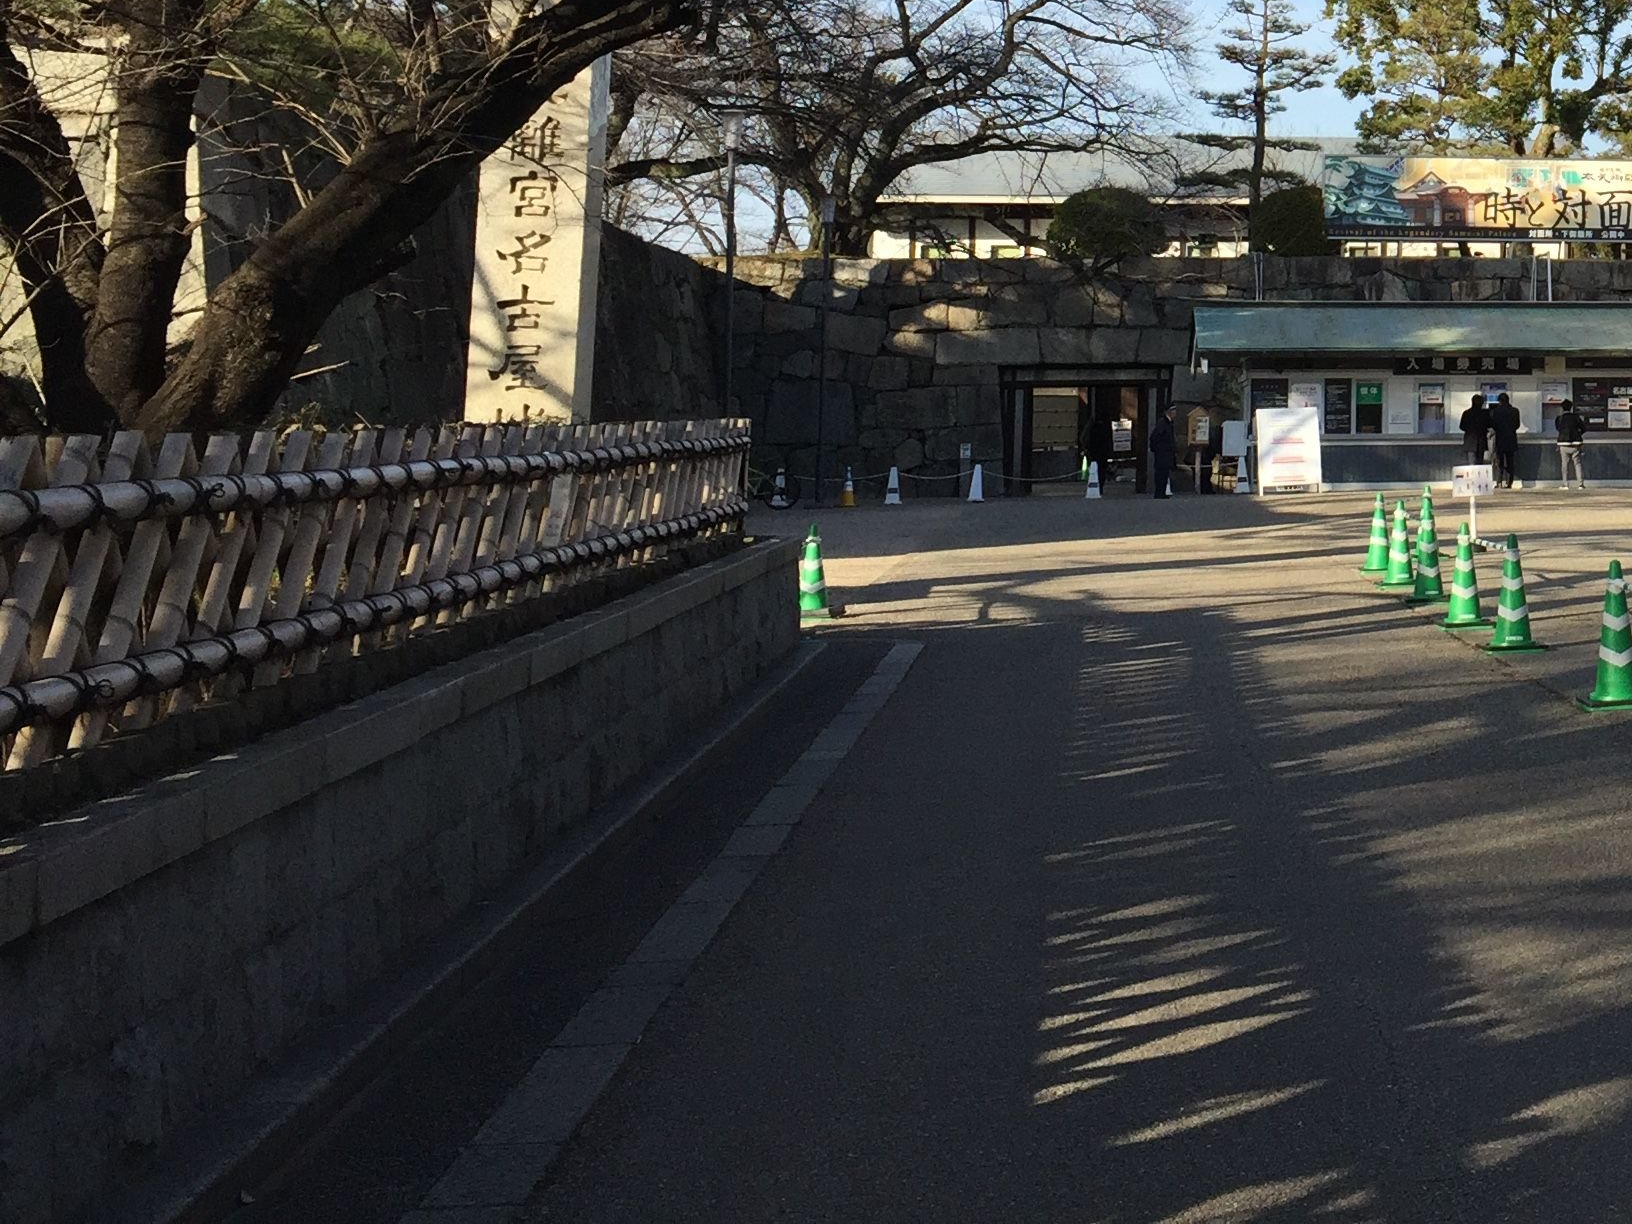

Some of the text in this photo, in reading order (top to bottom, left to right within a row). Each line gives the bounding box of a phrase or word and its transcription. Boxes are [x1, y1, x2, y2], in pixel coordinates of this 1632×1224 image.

[1398, 229, 1445, 238] Legendary
[1407, 357, 1520, 370] 入場券売場
